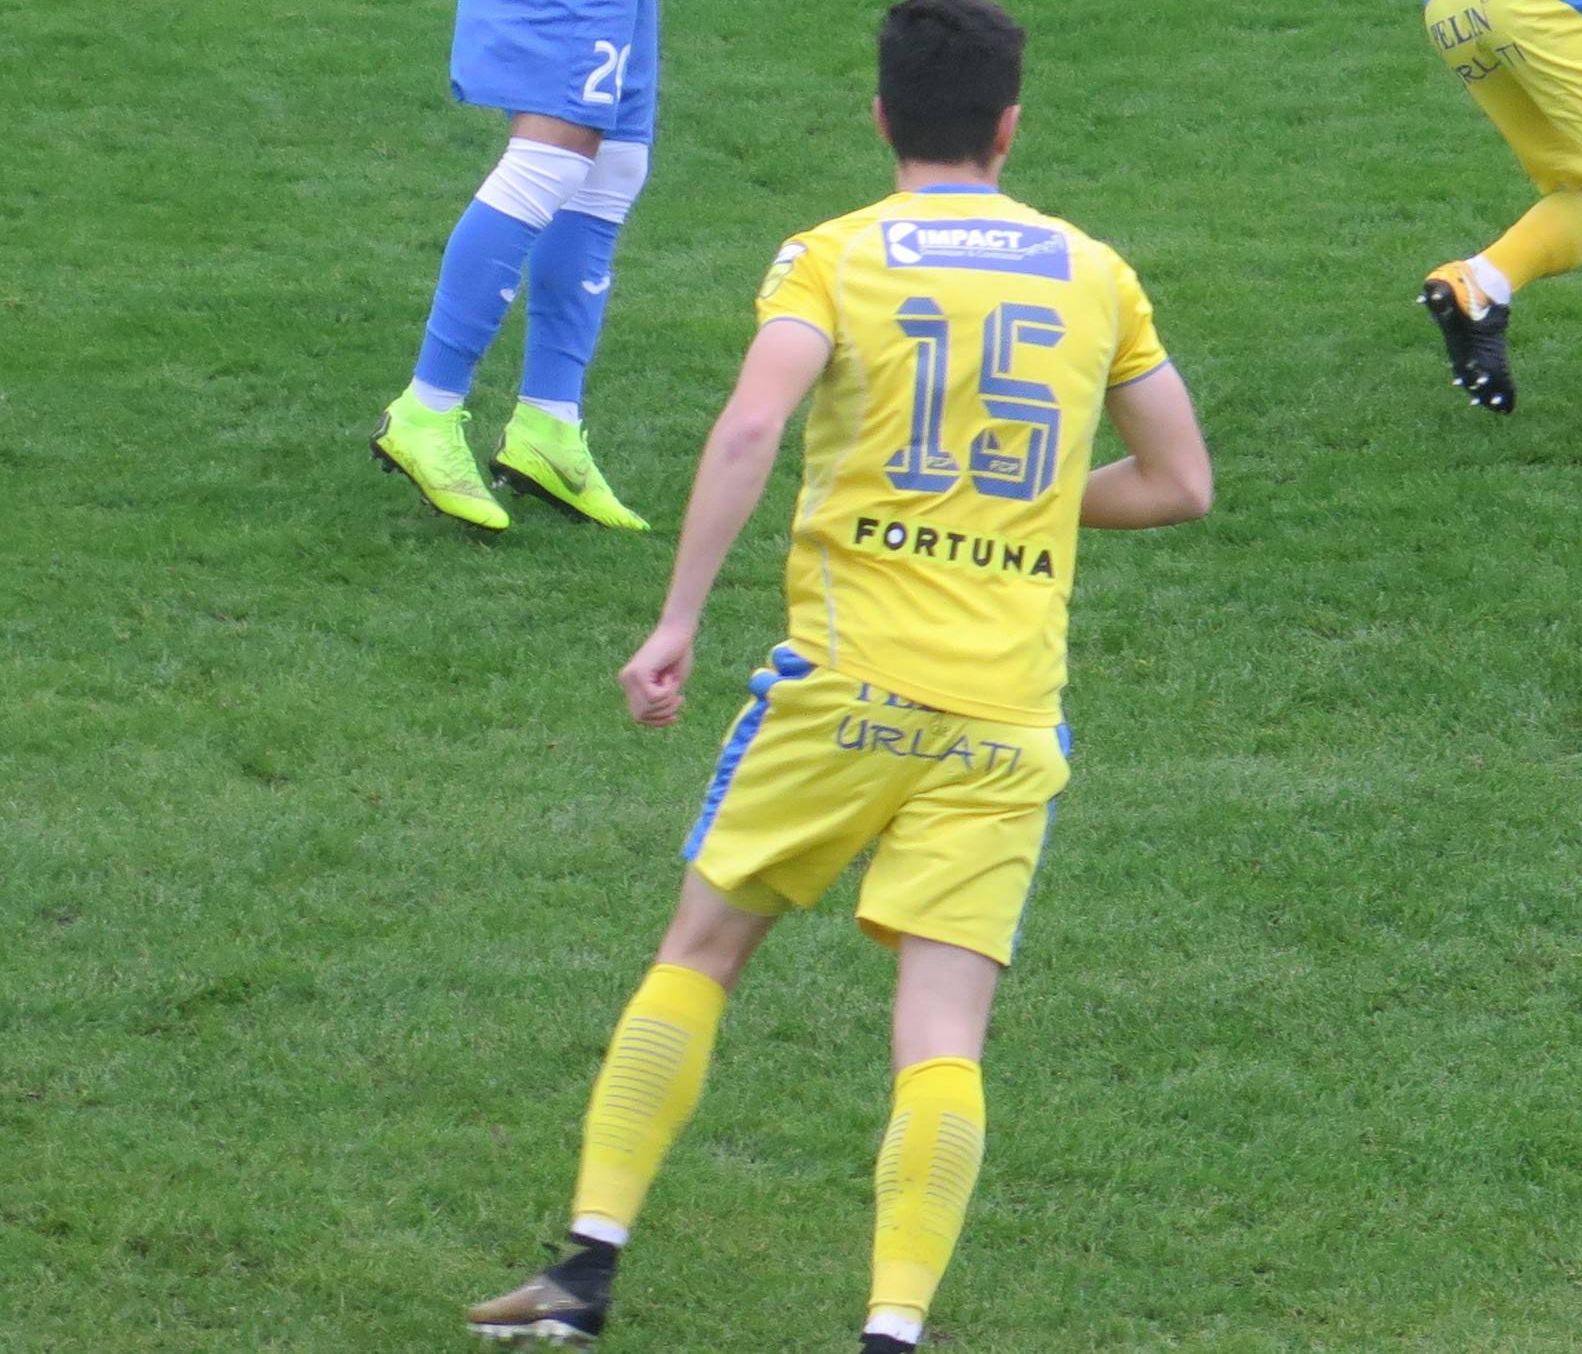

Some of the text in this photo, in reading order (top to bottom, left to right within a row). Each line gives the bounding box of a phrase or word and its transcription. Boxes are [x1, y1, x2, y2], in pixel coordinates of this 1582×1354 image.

[917, 229, 1023, 248] IMPACT
[884, 296, 1066, 502] 15
[854, 517, 1055, 578] FORTUNA
[837, 715, 1022, 774] URLATI
